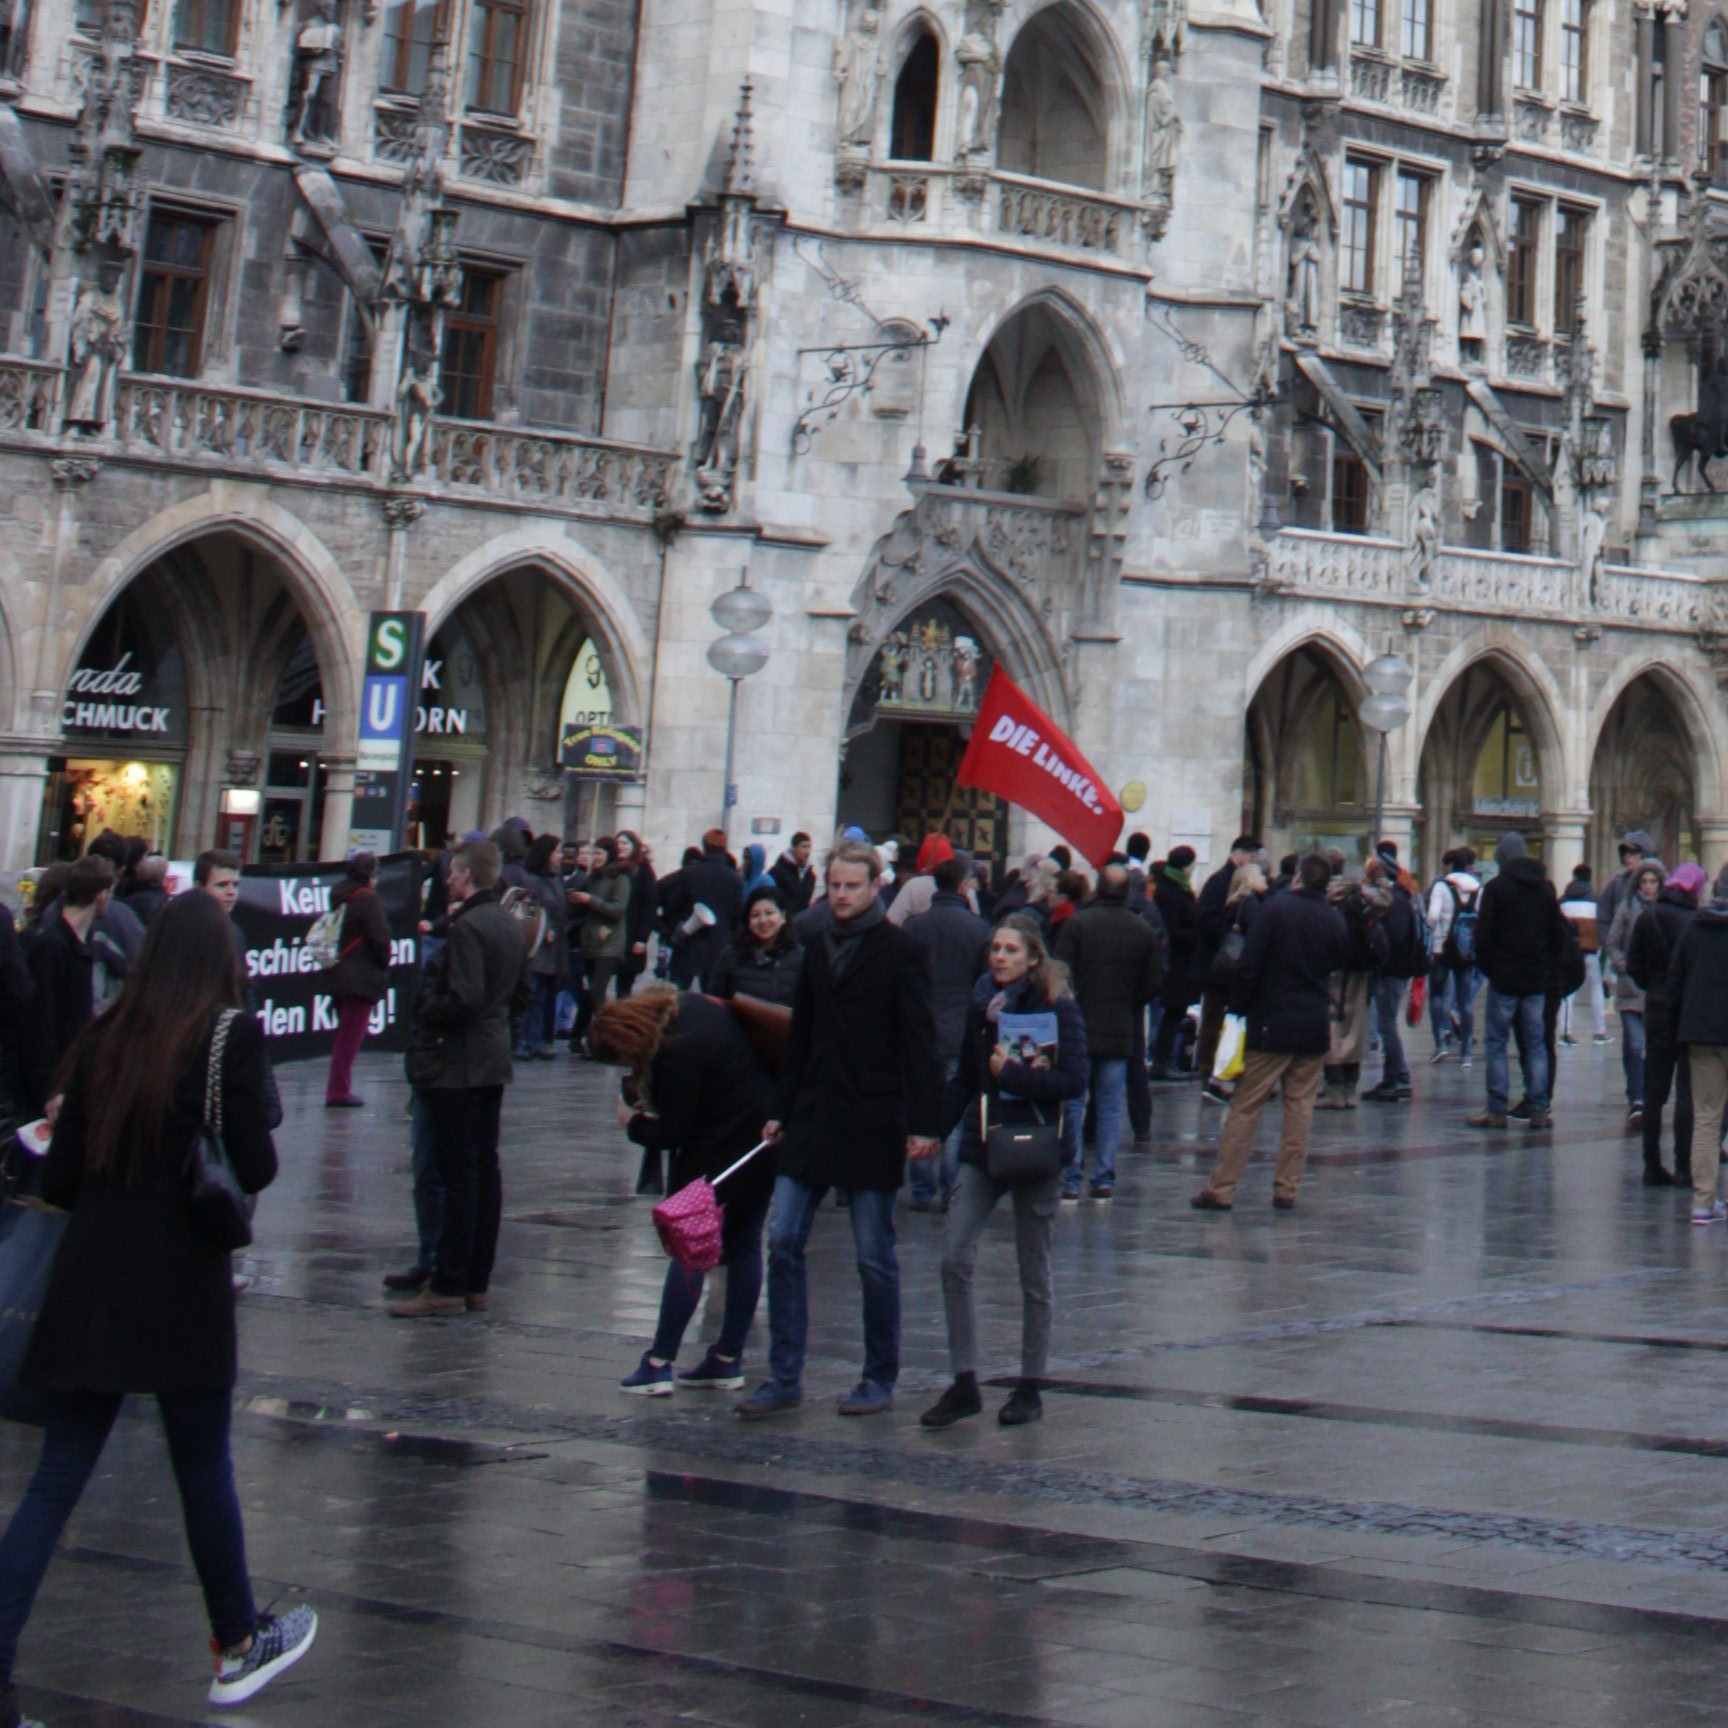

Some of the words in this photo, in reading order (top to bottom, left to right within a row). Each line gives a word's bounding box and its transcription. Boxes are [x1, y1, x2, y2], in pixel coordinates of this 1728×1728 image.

[375, 619, 404, 668] S
[61, 701, 171, 732] CHMUCK
[369, 683, 397, 731] U
[988, 713, 1040, 757] DIE
[1032, 741, 1103, 815] LINKE.
[279, 877, 332, 915] Kein
